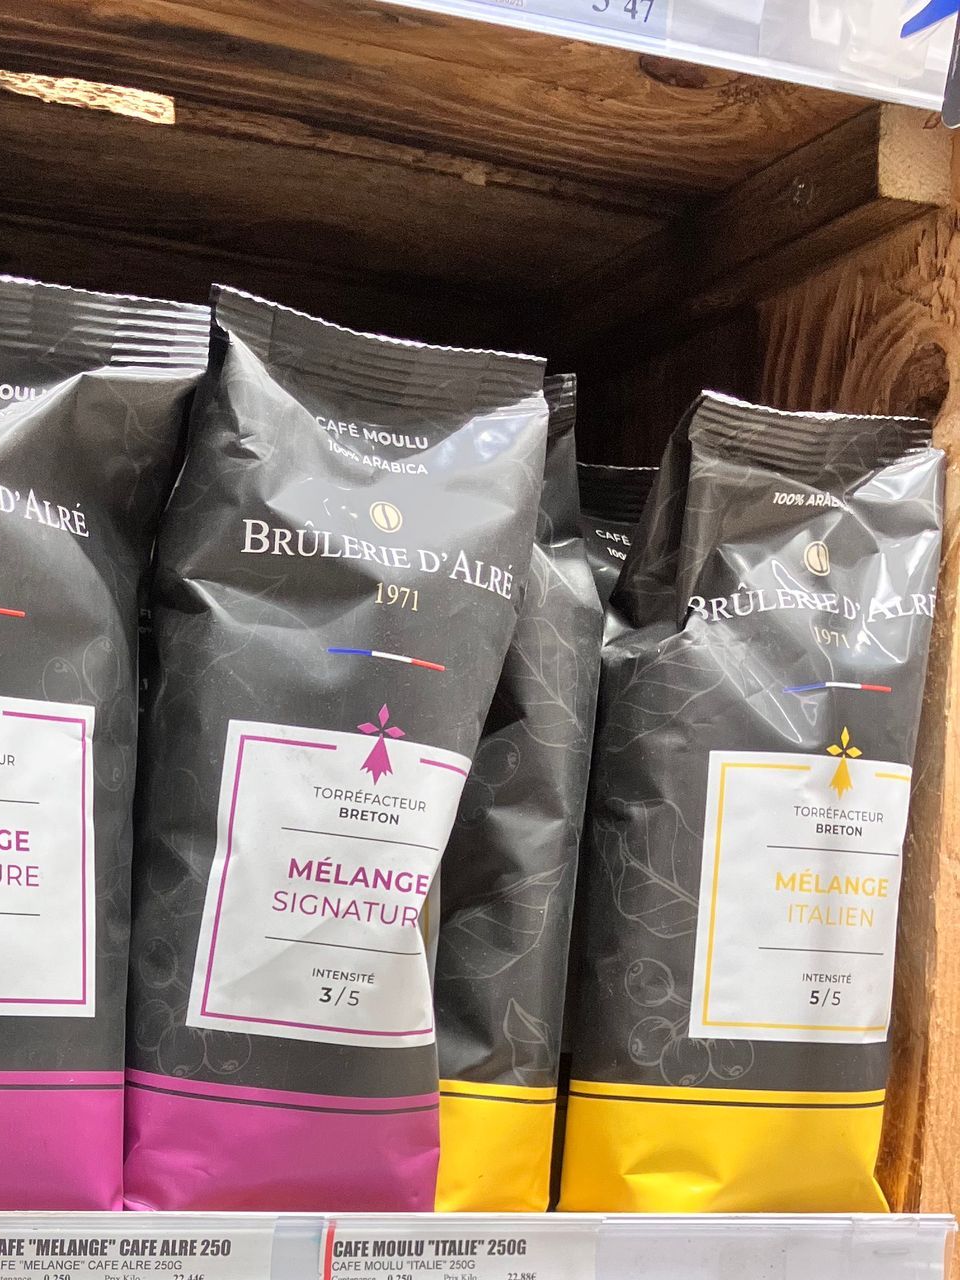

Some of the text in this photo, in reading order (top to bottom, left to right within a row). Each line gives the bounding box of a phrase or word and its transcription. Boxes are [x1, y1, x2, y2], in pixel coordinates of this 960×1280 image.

[315, 416, 429, 450] CAFÉ MOULU
[362, 455, 429, 476] ARABICA
[772, 491, 805, 506] 100%
[595, 528, 632, 547] CAFÉ
[240, 518, 514, 600] BRÛLERIE D'ALRÉ
[374, 581, 419, 612] 1971
[686, 583, 840, 624] BRÛLERIE
[813, 625, 851, 649] 1971
[313, 786, 427, 813] TORRÉFACTEUR
[338, 807, 400, 826] BRETON
[793, 805, 884, 823] TORRÉFACTEUR
[815, 823, 863, 837] BRETON
[288, 857, 430, 896] MÉLANGE
[775, 868, 889, 898] MÉLANGE
[272, 890, 419, 928] SIGNATUR
[787, 903, 875, 928] ITALIEN
[311, 967, 375, 985] INTENSITÉ
[802, 973, 852, 985] INTENSITÉ
[28, 1238, 117, 1257] "MELANGE"
[119, 1239, 159, 1257] CAFE
[159, 1239, 198, 1257] ALRE
[200, 1239, 232, 1257] 250
[333, 1239, 528, 1258] CAFE MOULU "ITALIE" 250G
[19, 1260, 86, 1271] "MELANGE"
[88, 1260, 120, 1271] CAFE
[121, 1260, 152, 1271] ALRE
[154, 1260, 183, 1271] 250G
[331, 1260, 476, 1272] CAFE MOULU "ITALIE" 250G
